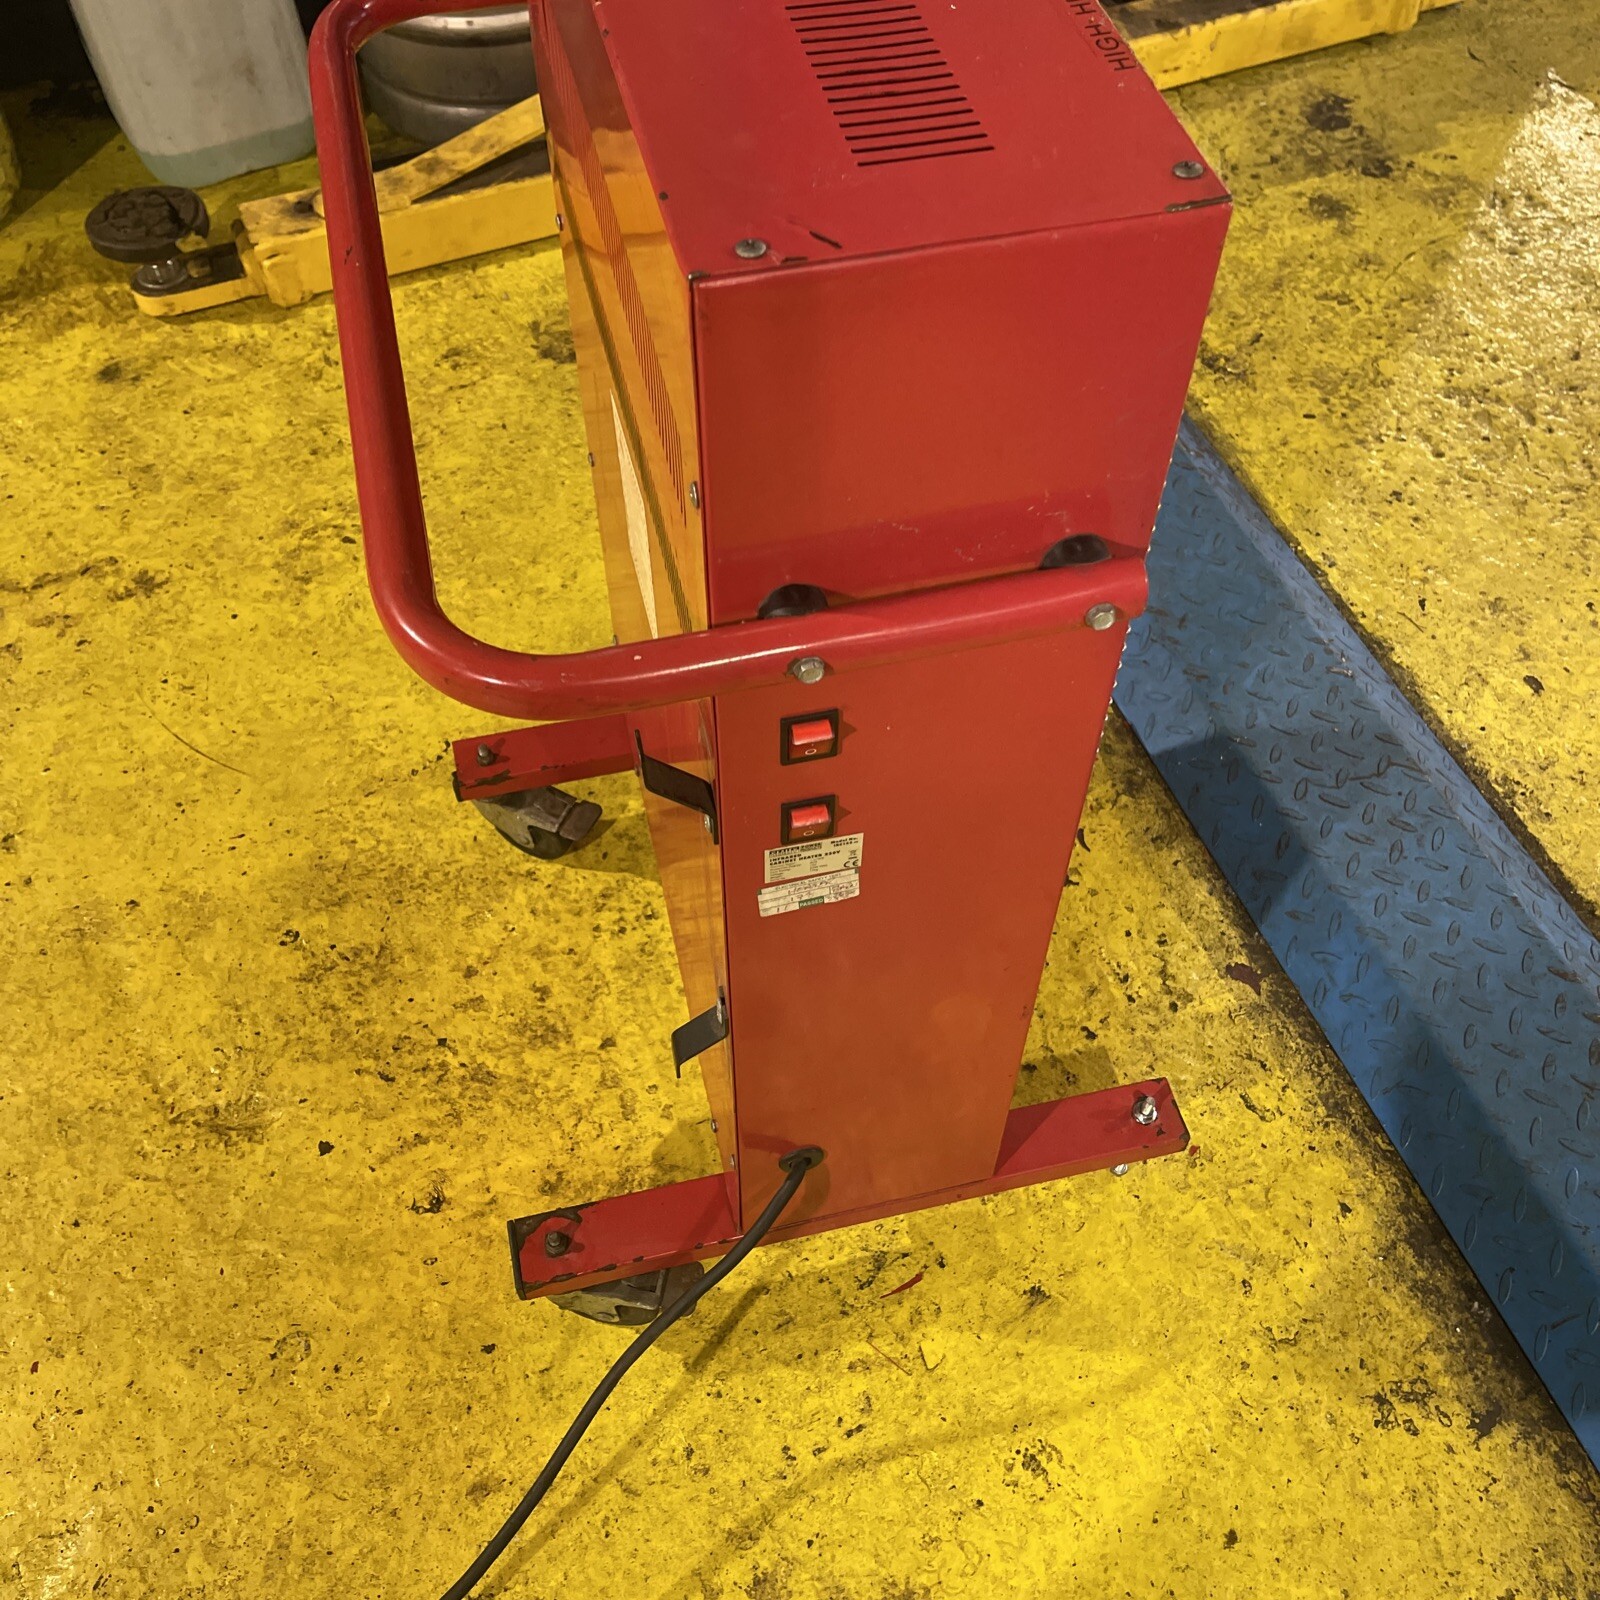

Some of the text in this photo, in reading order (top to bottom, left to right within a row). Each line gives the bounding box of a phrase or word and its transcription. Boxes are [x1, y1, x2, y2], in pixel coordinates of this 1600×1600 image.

[1084, 24, 1136, 71] HIGH
[769, 853, 802, 863] INFRARED
[769, 857, 796, 866] CABINET
[798, 853, 822, 861] HEATER
[799, 898, 824, 907] PASSED
